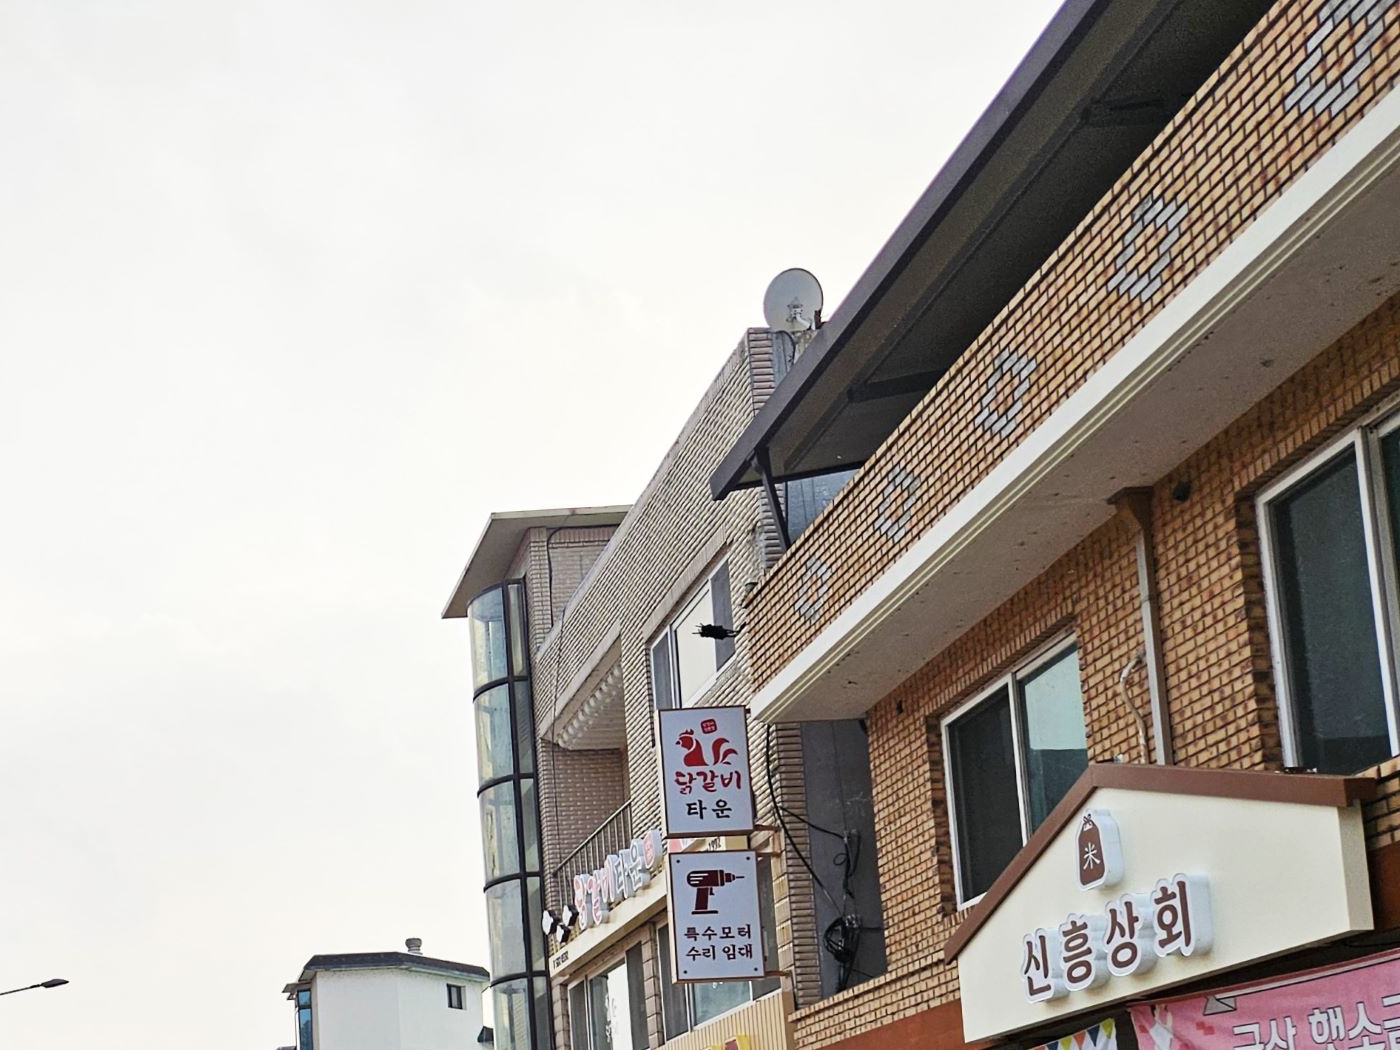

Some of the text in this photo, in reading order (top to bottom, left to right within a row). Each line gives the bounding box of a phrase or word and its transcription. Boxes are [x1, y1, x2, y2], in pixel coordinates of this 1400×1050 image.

[675, 770, 741, 794] 닭갈비
[686, 799, 732, 820] 타운
[1083, 841, 1101, 869] 米
[684, 924, 751, 941] 특수모터
[1022, 880, 1193, 997] 신흥상회
[686, 944, 753, 961] 수리 임대
